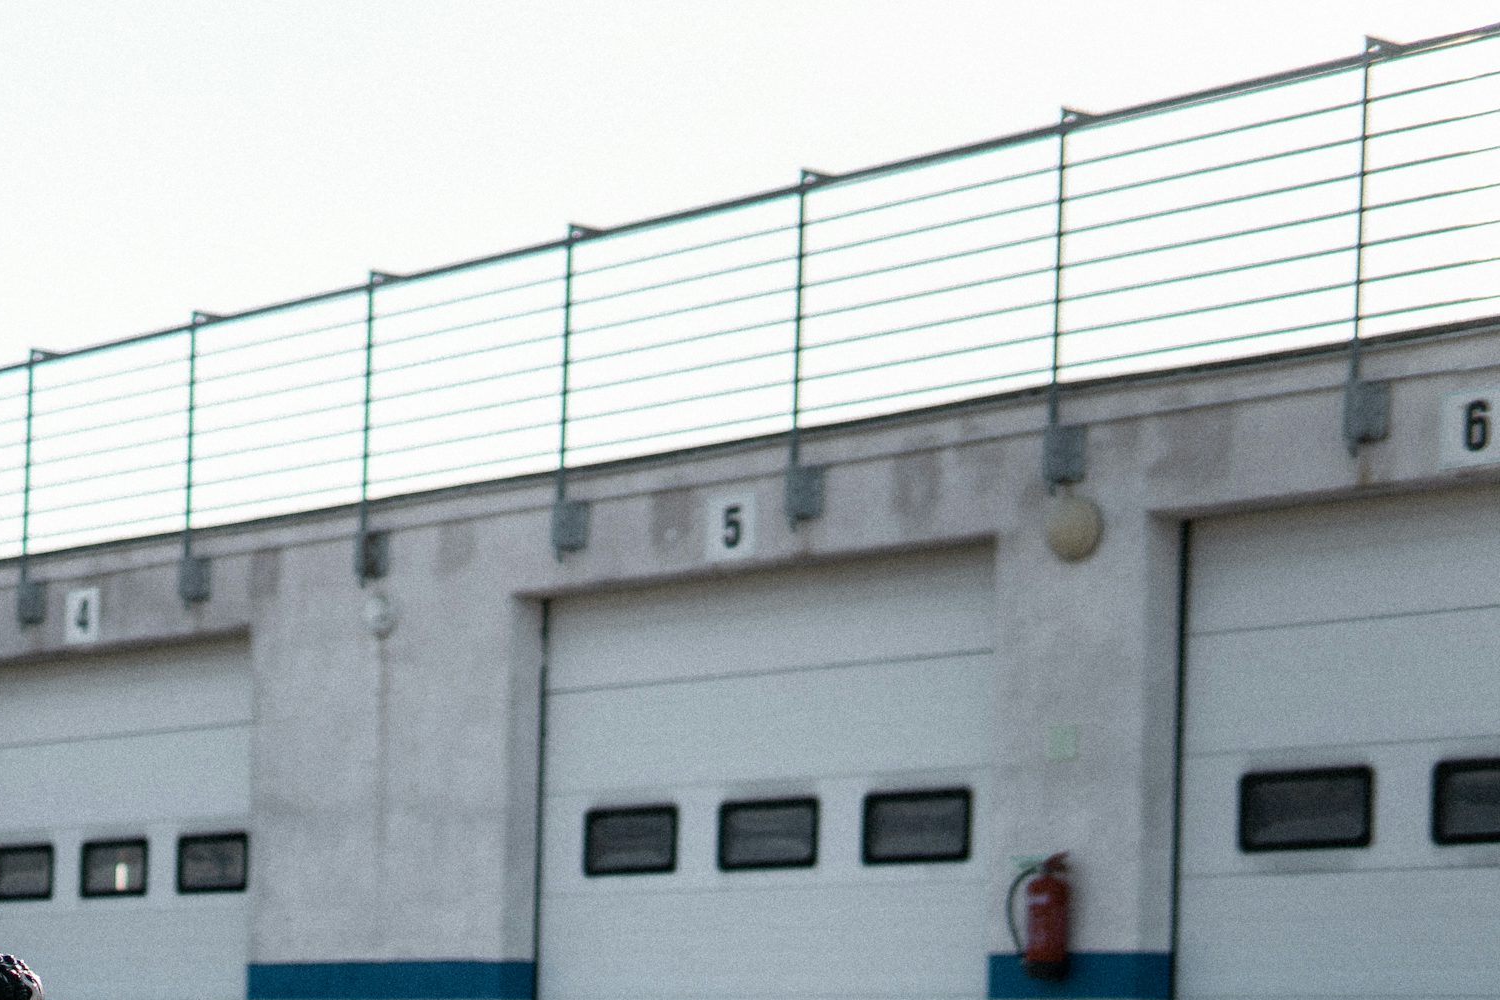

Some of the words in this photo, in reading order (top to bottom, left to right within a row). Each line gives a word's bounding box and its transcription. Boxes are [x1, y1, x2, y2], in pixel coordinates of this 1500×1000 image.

[1463, 399, 1490, 452] 6
[723, 506, 741, 549] 5
[75, 599, 89, 634] 4
